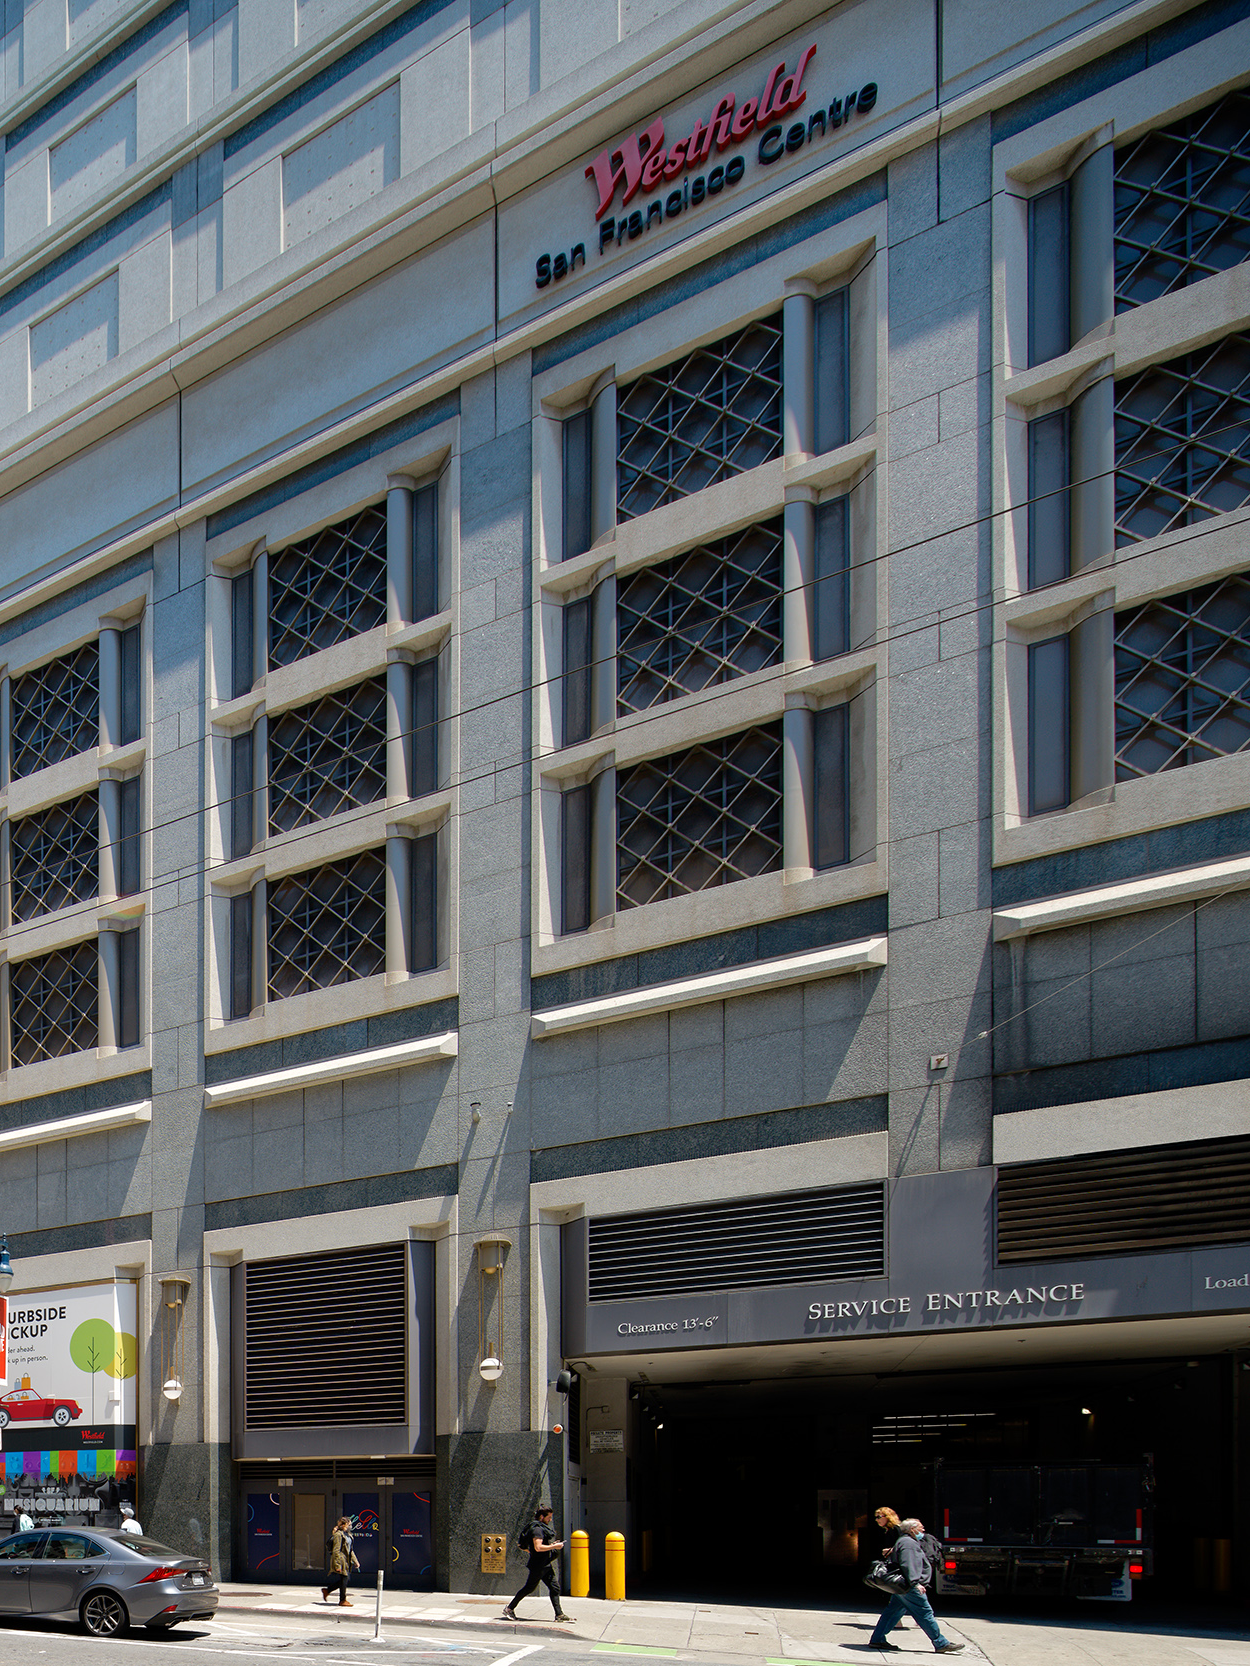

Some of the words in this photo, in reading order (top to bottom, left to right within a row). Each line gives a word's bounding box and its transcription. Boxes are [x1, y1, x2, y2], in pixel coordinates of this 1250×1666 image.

[584, 43, 817, 221] Westfield
[535, 241, 586, 289] San
[598, 154, 745, 256] Francisco
[758, 82, 878, 165] Centre
[1204, 1273, 1250, 1290] Load
[808, 1297, 911, 1320] SERVICE
[926, 1283, 1085, 1311] ENTRANCE
[8, 1306, 67, 1324] URBSIDE
[8, 1324, 48, 1339] ICKUP
[617, 1322, 678, 1334] Clearance
[8, 1346, 16, 1354] der
[16, 1345, 36, 1354] ahead.
[27, 1355, 48, 1365] person.
[81, 1430, 105, 1440] Westfield
